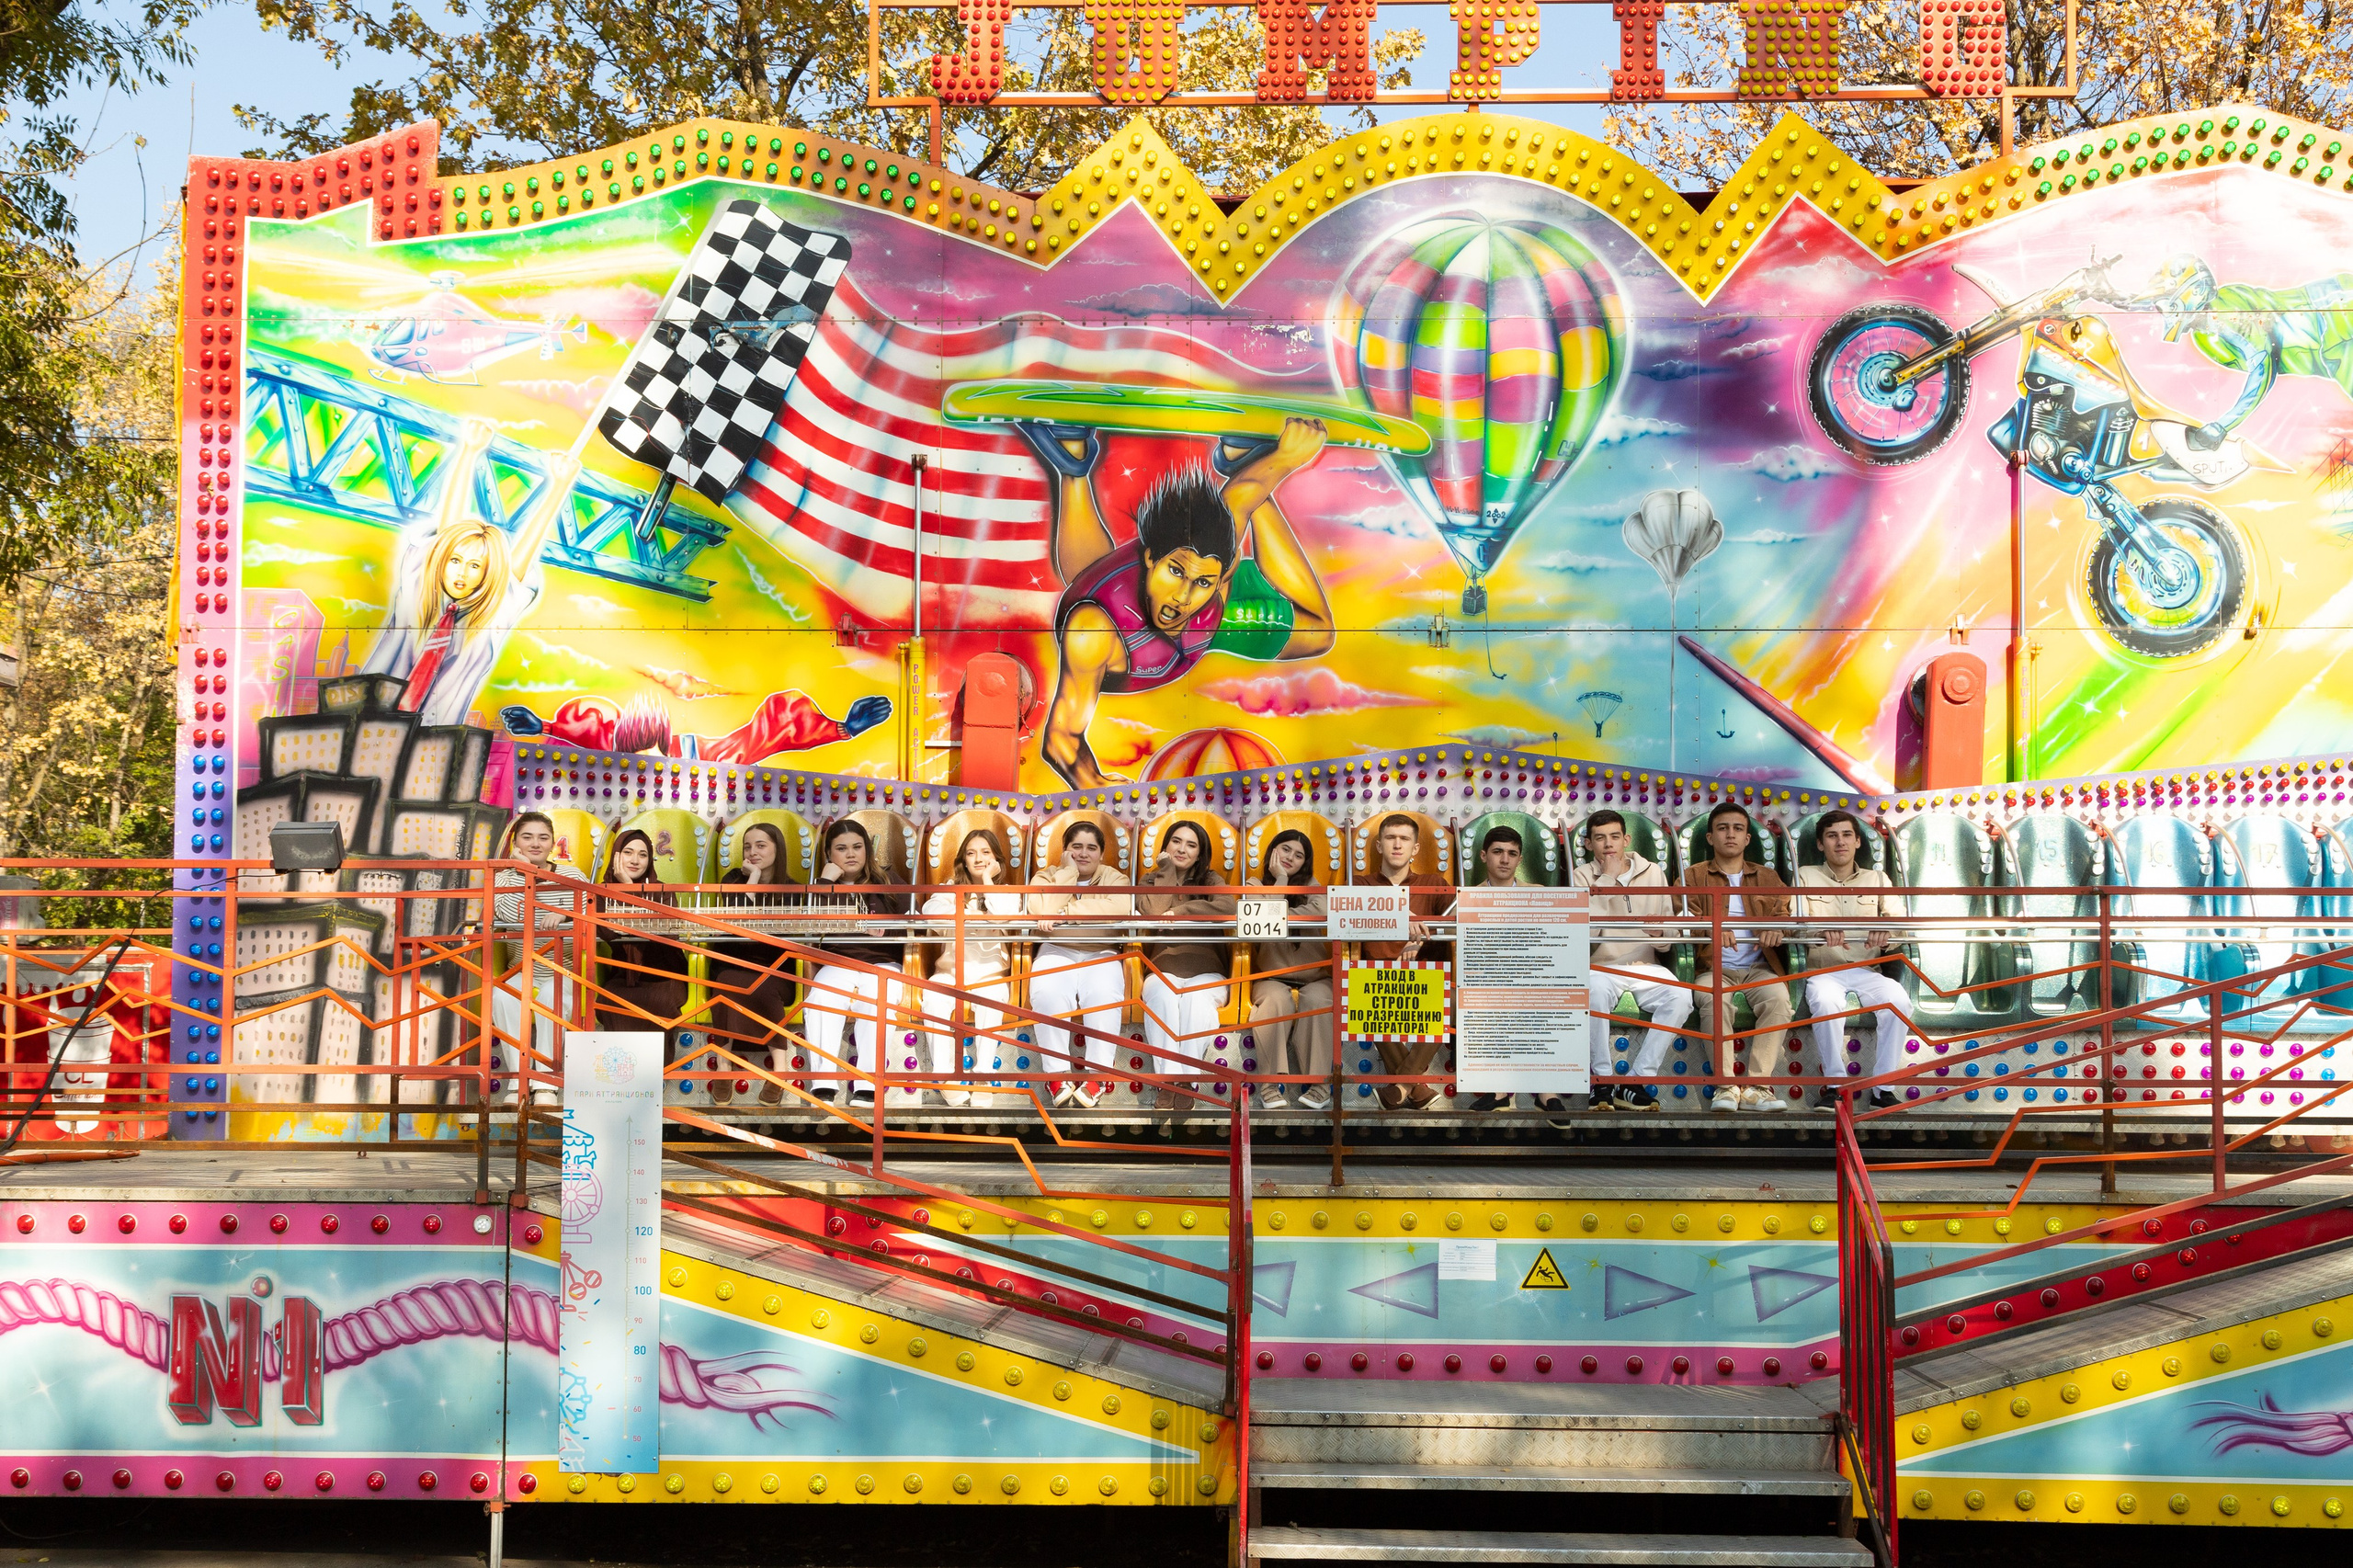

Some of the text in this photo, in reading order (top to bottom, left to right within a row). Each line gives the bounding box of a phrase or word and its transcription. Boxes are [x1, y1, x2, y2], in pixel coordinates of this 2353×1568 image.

[931, 0, 2006, 103] JUMPING
[1236, 608, 1283, 620] Super
[1135, 665, 1163, 675] Super
[912, 664, 920, 716] POWER
[555, 835, 571, 859] 1
[655, 830, 676, 857] 2
[2037, 837, 2060, 862] 15
[1244, 903, 1262, 916] 07
[1330, 897, 1407, 913] ЦЕНА 200 Р
[1243, 922, 1281, 936] 0014
[1339, 918, 1398, 929] С ЧЕЛОВЕКА
[1377, 971, 1415, 983] ВХОД В
[1363, 983, 1428, 997] АТРАКЦИОН
[1371, 996, 1420, 1009] СТРОГО
[1349, 1009, 1442, 1022] ПО РАЗРЕШЕНИЮ
[1362, 1022, 1429, 1034] ОПЕРАТОРА!
[634, 1226, 654, 1236] 120
[633, 1286, 652, 1296] 100
[633, 1345, 646, 1355] 80
